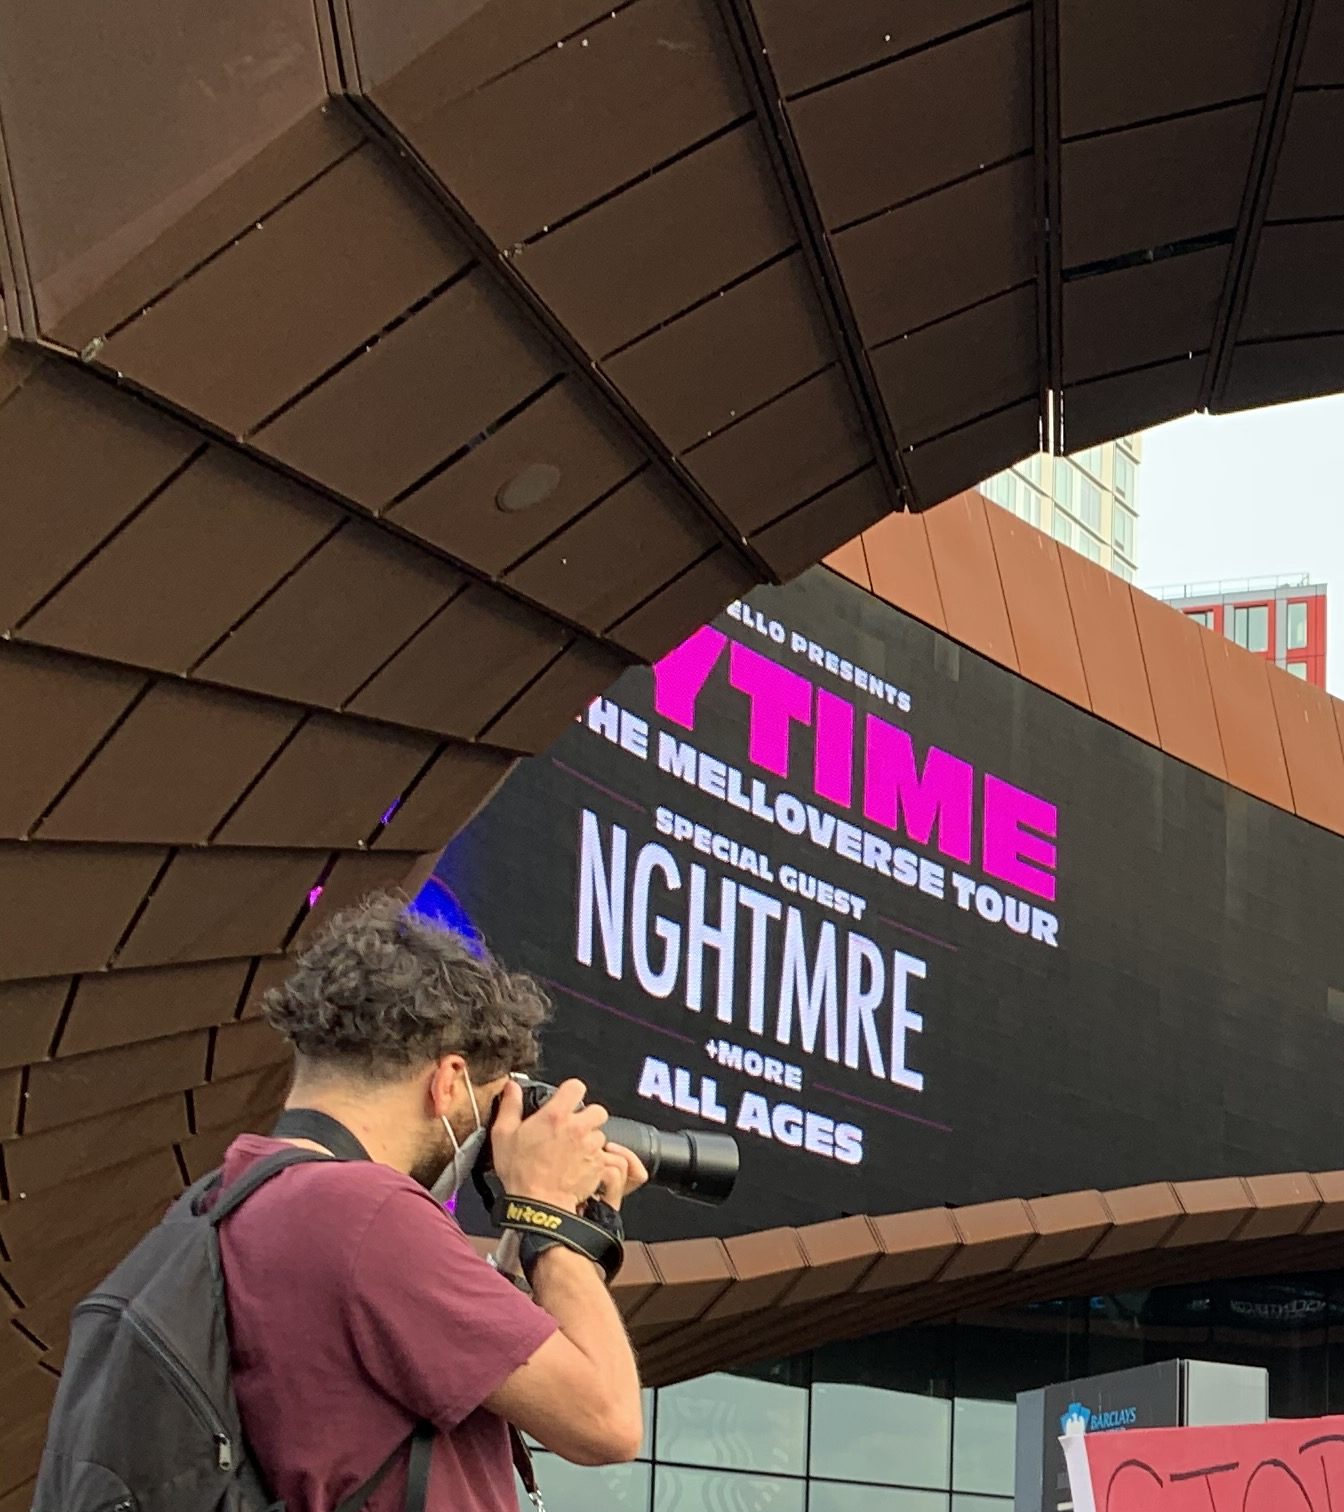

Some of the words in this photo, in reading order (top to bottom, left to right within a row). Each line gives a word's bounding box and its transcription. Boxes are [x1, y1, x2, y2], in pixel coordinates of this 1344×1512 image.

[791, 631, 912, 713] PRESENTS
[580, 697, 648, 760] HE
[658, 731, 945, 901] MELLOVERSE
[953, 880, 1060, 948] TOUR
[656, 806, 773, 882] SPECIAL
[779, 863, 867, 920] GUEST
[577, 808, 928, 1092] NGHTMRE
[638, 1056, 727, 1125] ALL
[735, 1093, 865, 1166] AGES
[705, 1039, 803, 1092] +MORE
[506, 1202, 563, 1230] Nikon
[1090, 1406, 1137, 1431] BARCLAYS
